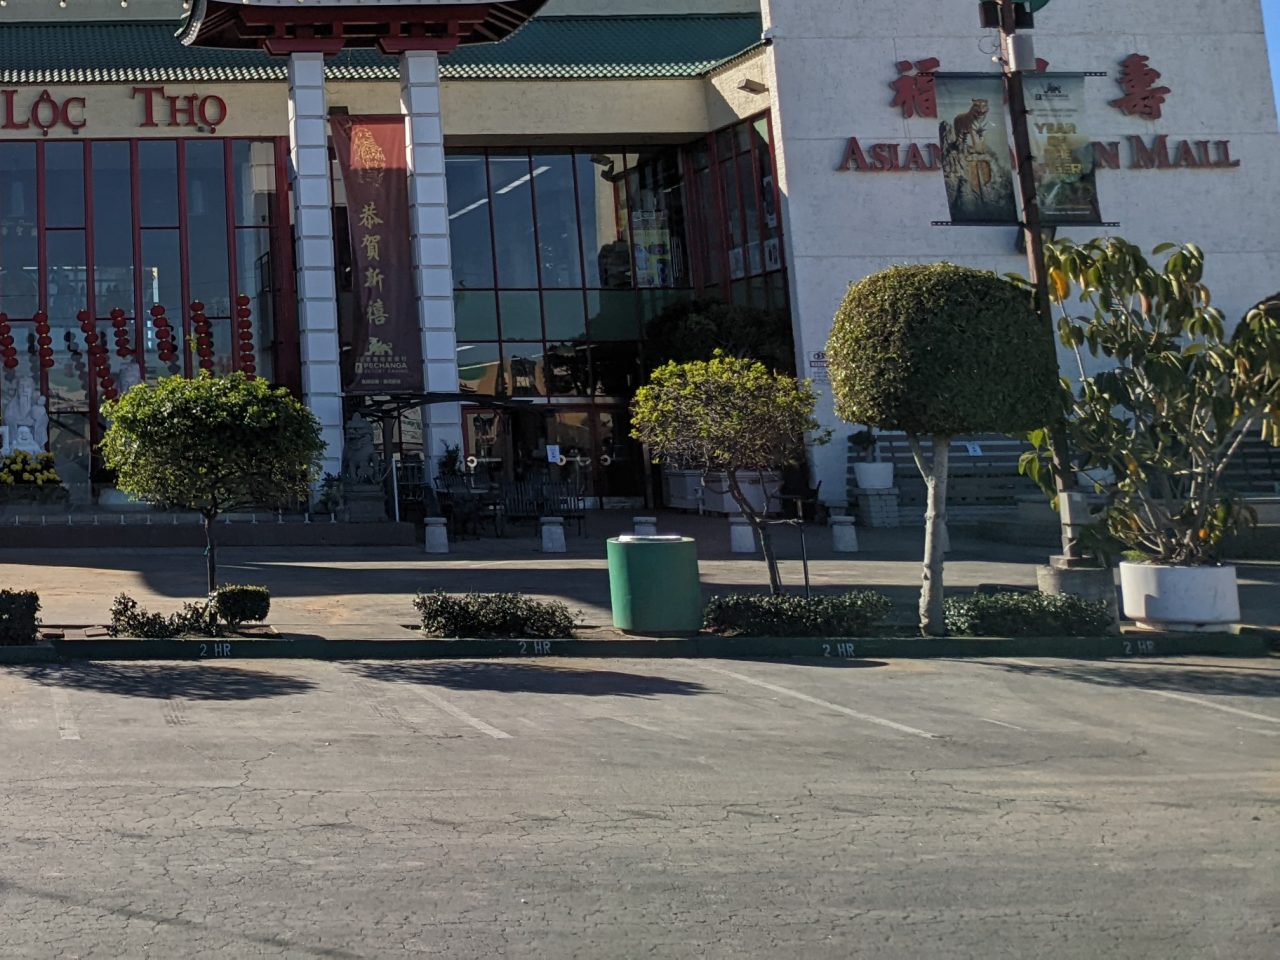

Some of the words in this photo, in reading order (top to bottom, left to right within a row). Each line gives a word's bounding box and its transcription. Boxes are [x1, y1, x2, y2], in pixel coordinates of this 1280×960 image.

[1110, 53, 1171, 120] 壽
[1128, 135, 1240, 170] MALL
[200, 643, 208, 656] 2
[215, 643, 231, 656] HR
[518, 641, 527, 654] 2
[534, 641, 551, 654] HR
[822, 644, 831, 657] 2
[837, 643, 855, 657] HR
[1123, 641, 1132, 654] 2
[1137, 640, 1154, 654] HR
